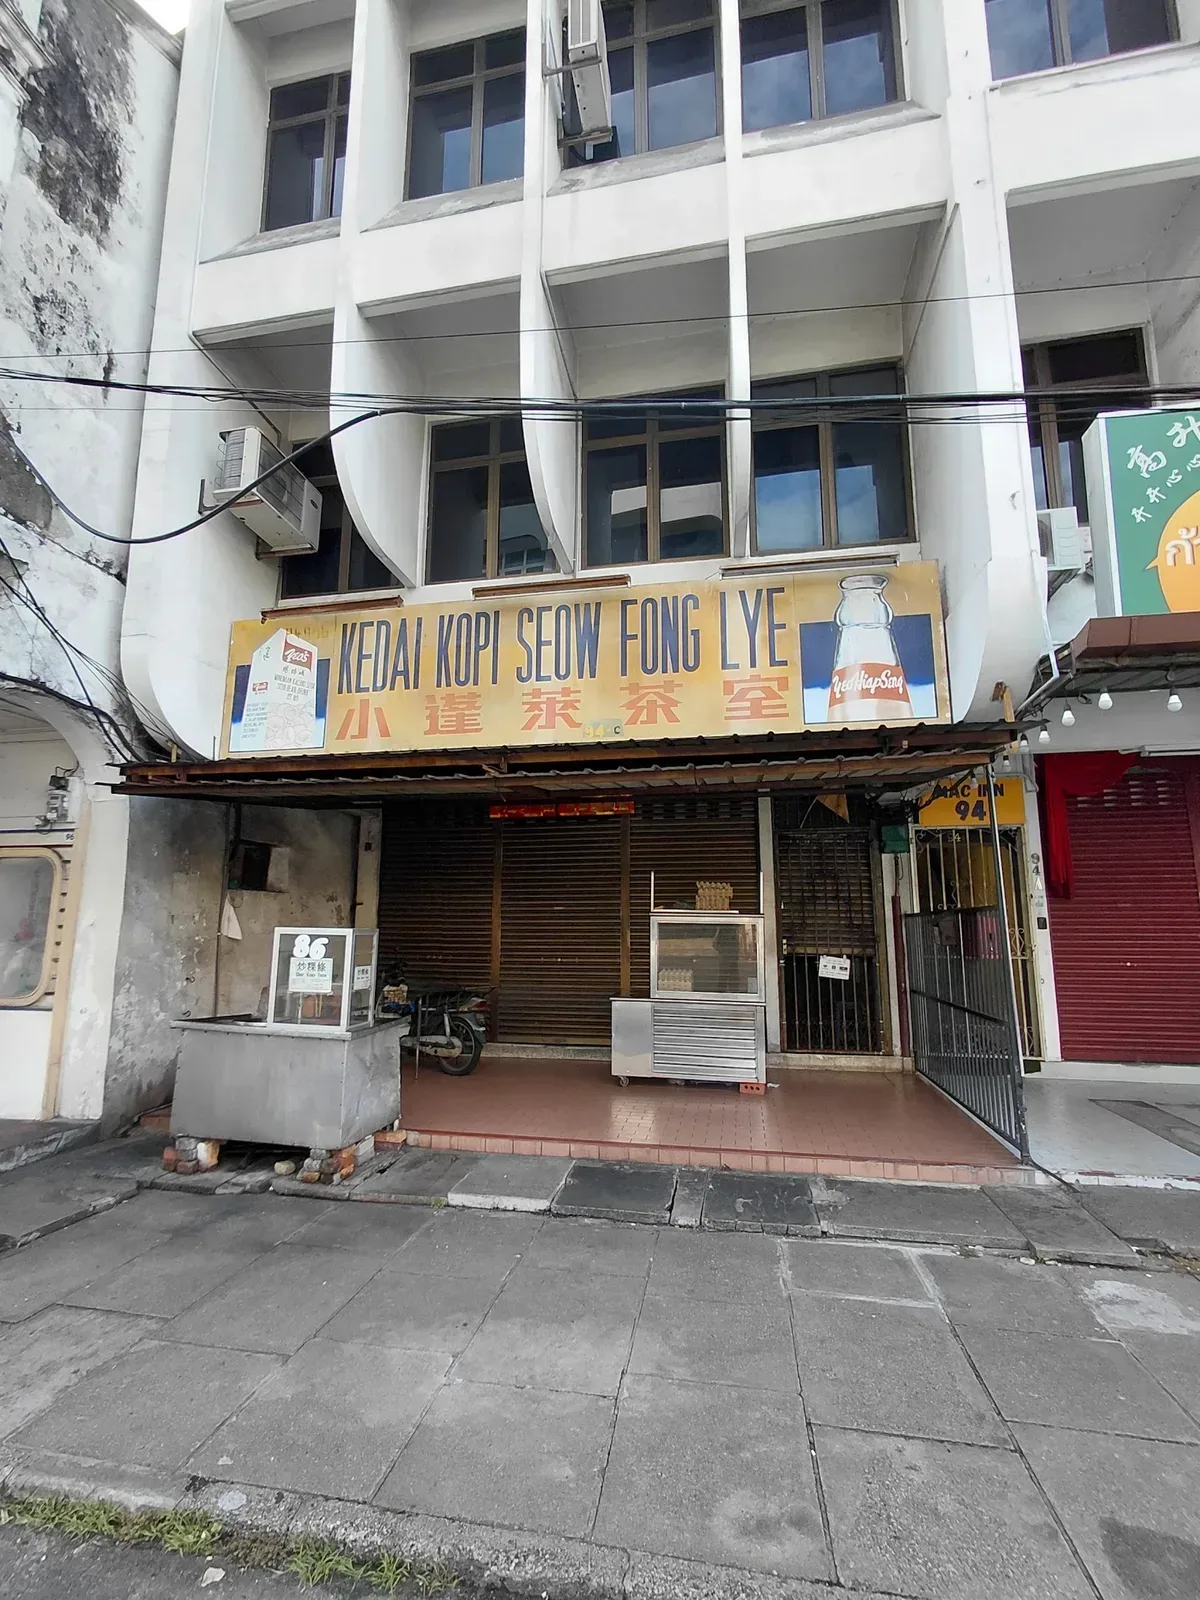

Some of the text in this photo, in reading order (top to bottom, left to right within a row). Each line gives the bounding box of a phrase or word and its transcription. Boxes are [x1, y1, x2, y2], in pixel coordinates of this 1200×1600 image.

[337, 586, 789, 695] KEDAI KOPI SEOW FONG LYE
[955, 800, 987, 821] 94
[293, 934, 329, 960] 86
